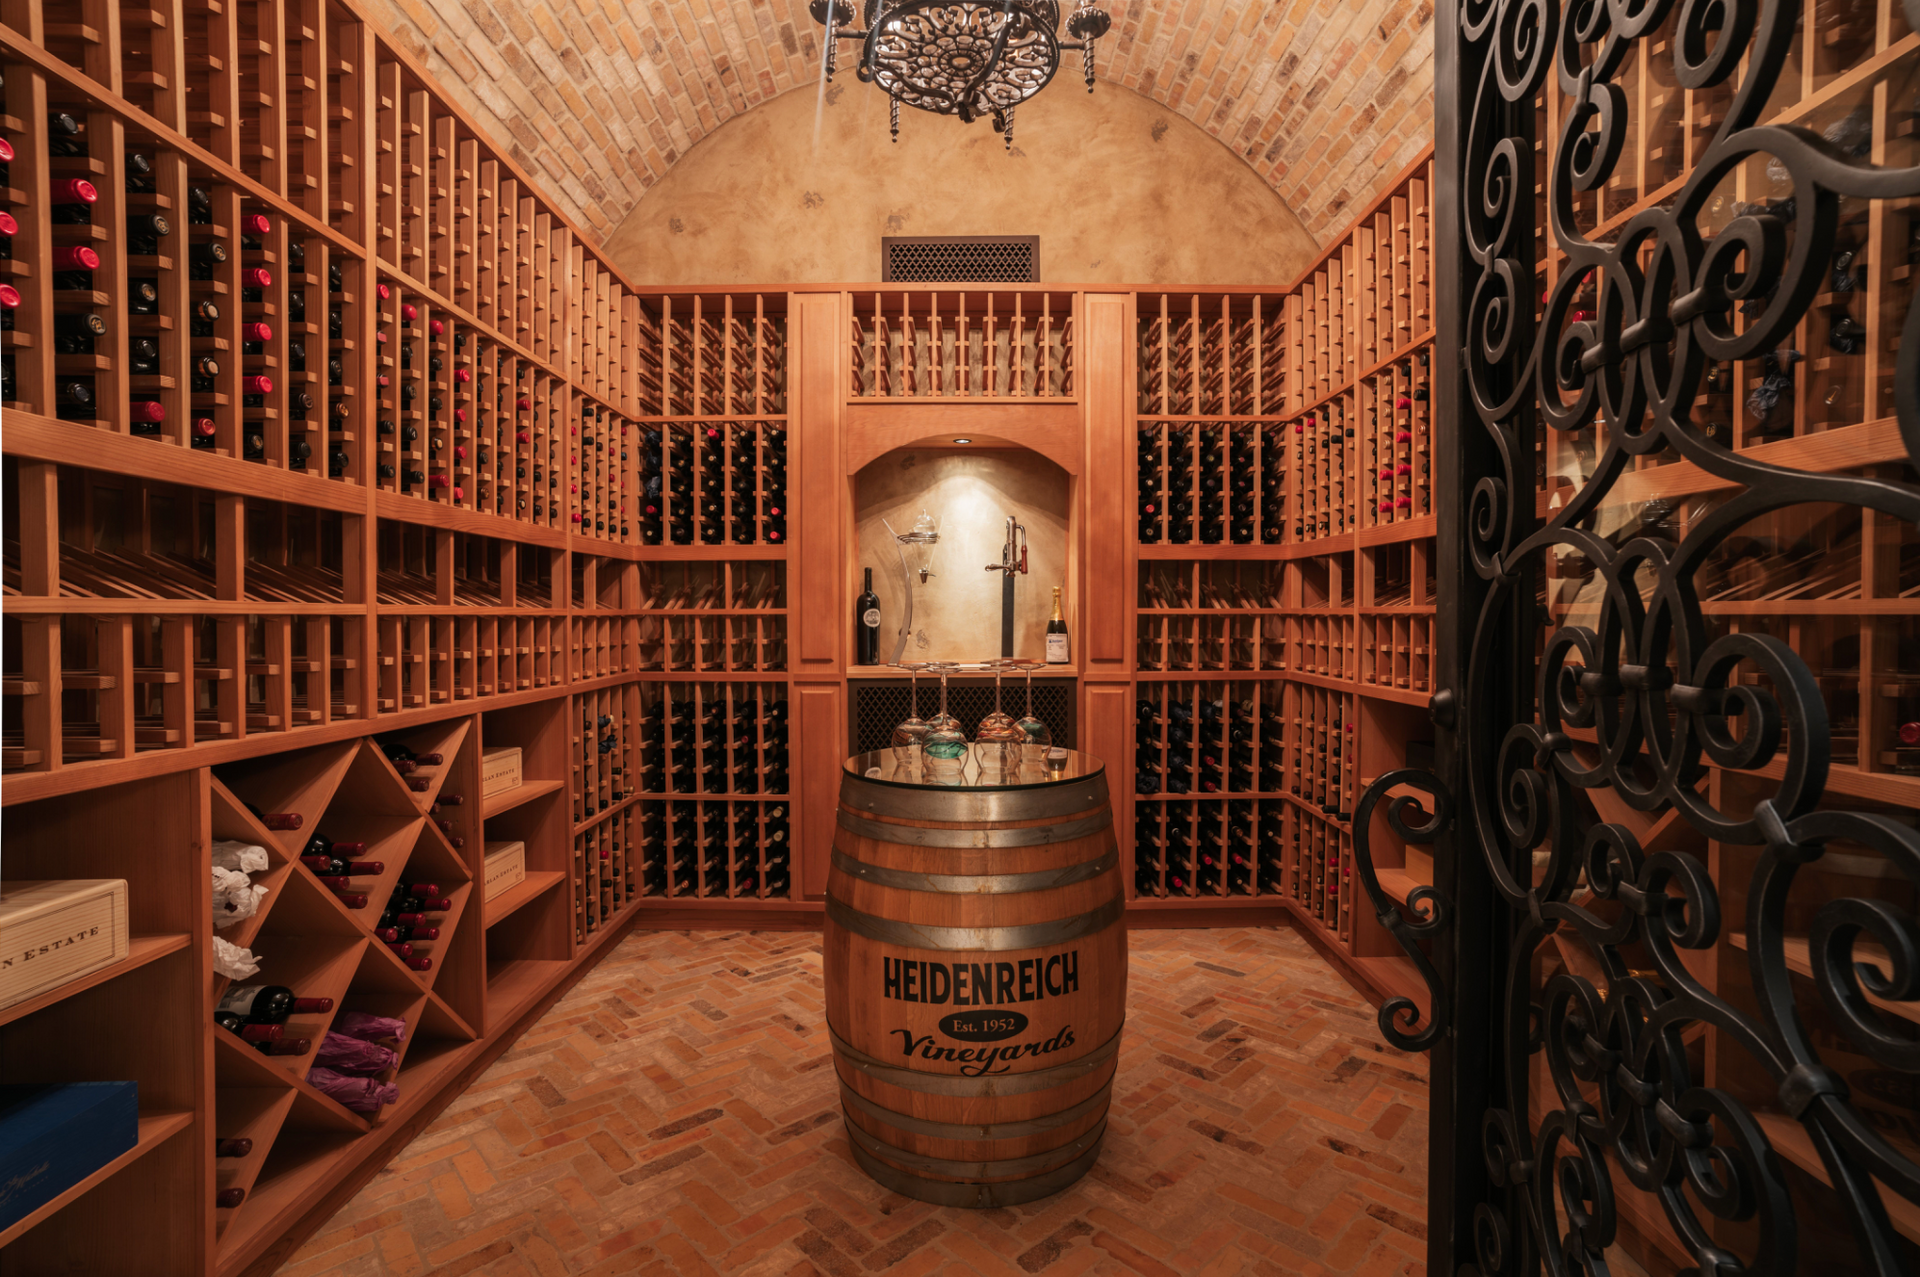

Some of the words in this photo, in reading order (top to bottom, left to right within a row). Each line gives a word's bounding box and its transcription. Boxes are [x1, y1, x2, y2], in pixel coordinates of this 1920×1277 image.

[23, 926, 99, 962] ESTATE
[883, 950, 1079, 1006] HEIDENREICH
[952, 1020, 978, 1032] Est.
[982, 1018, 1015, 1032] 1952
[889, 1025, 1076, 1077] Vineyards
